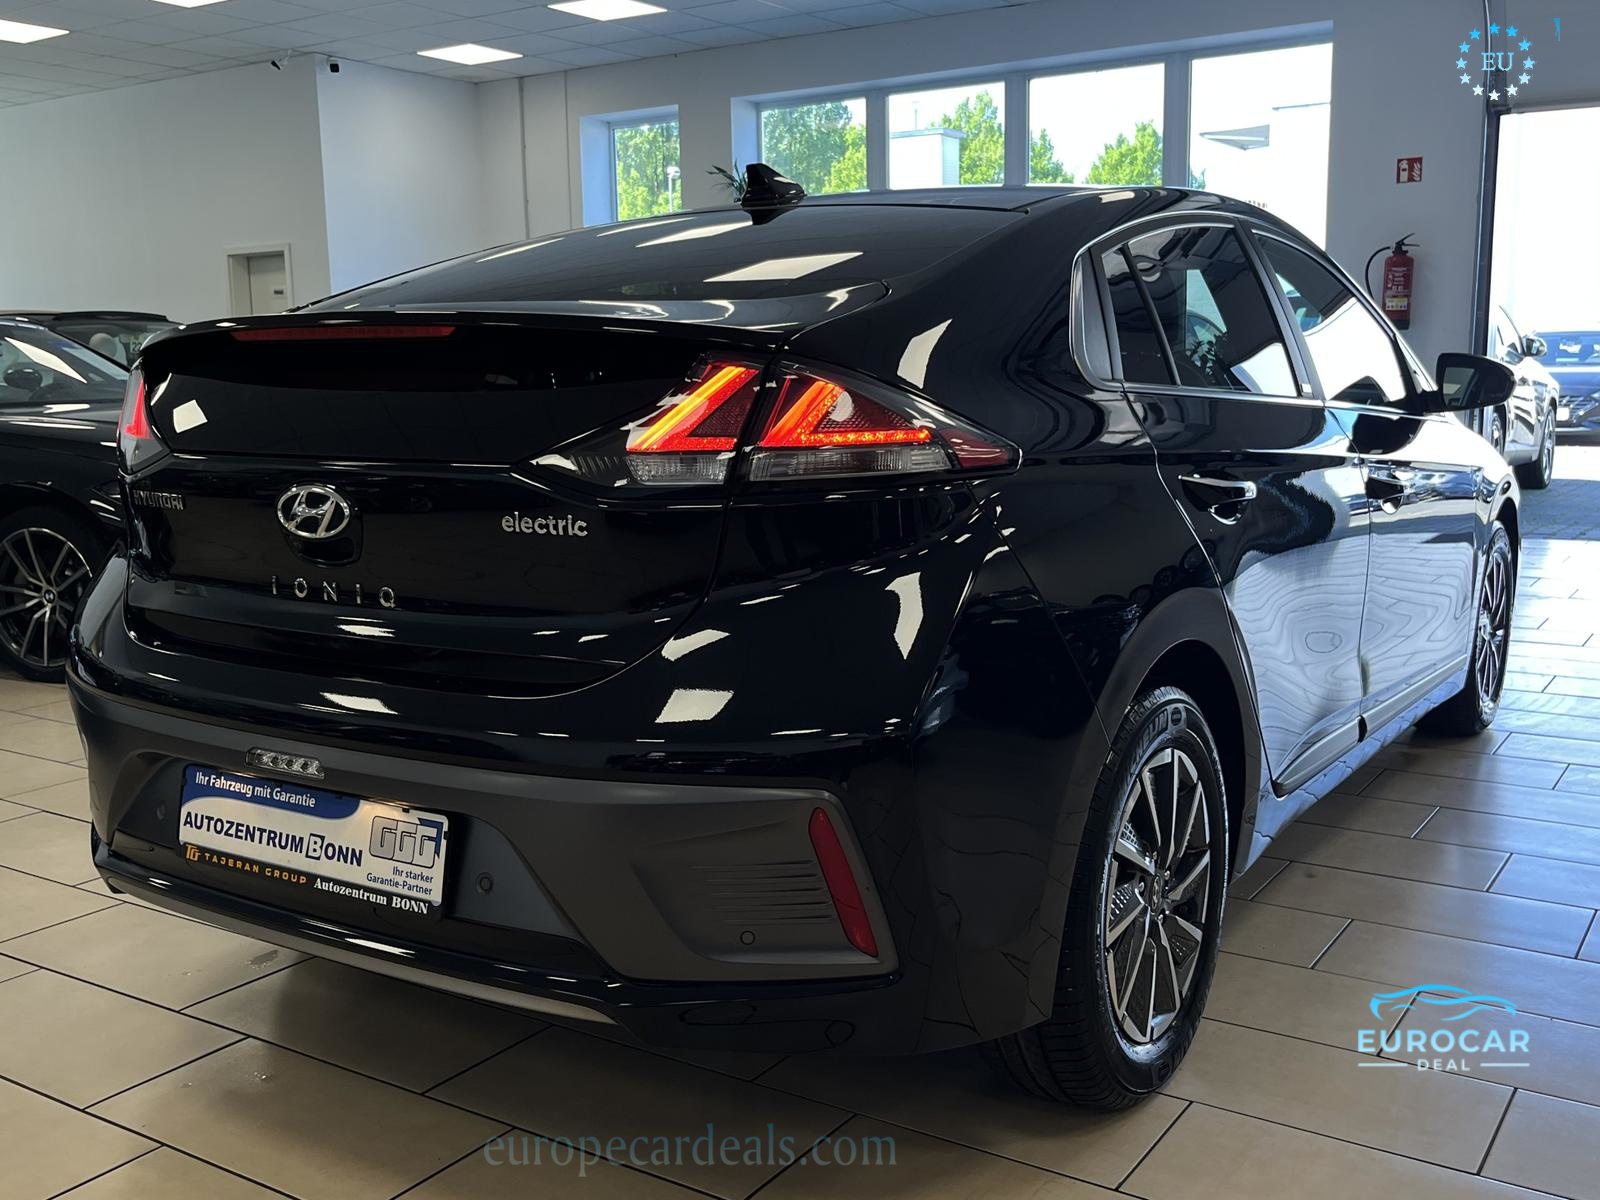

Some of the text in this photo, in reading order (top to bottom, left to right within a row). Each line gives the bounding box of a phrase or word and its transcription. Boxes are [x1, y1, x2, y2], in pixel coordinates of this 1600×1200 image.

[501, 511, 588, 537] electric
[271, 575, 396, 608] IONIQ
[195, 771, 316, 807] Ihr Fahrzeug mit Garantie
[183, 811, 363, 867] AUTOZENTRUM BONN
[204, 852, 260, 873] TAJERAN
[265, 868, 307, 884] GROUP
[314, 878, 387, 906] Autozentrum
[391, 895, 429, 915] BONN
[366, 873, 433, 896] Garantie-Partner
[392, 866, 434, 884] Ihr starker
